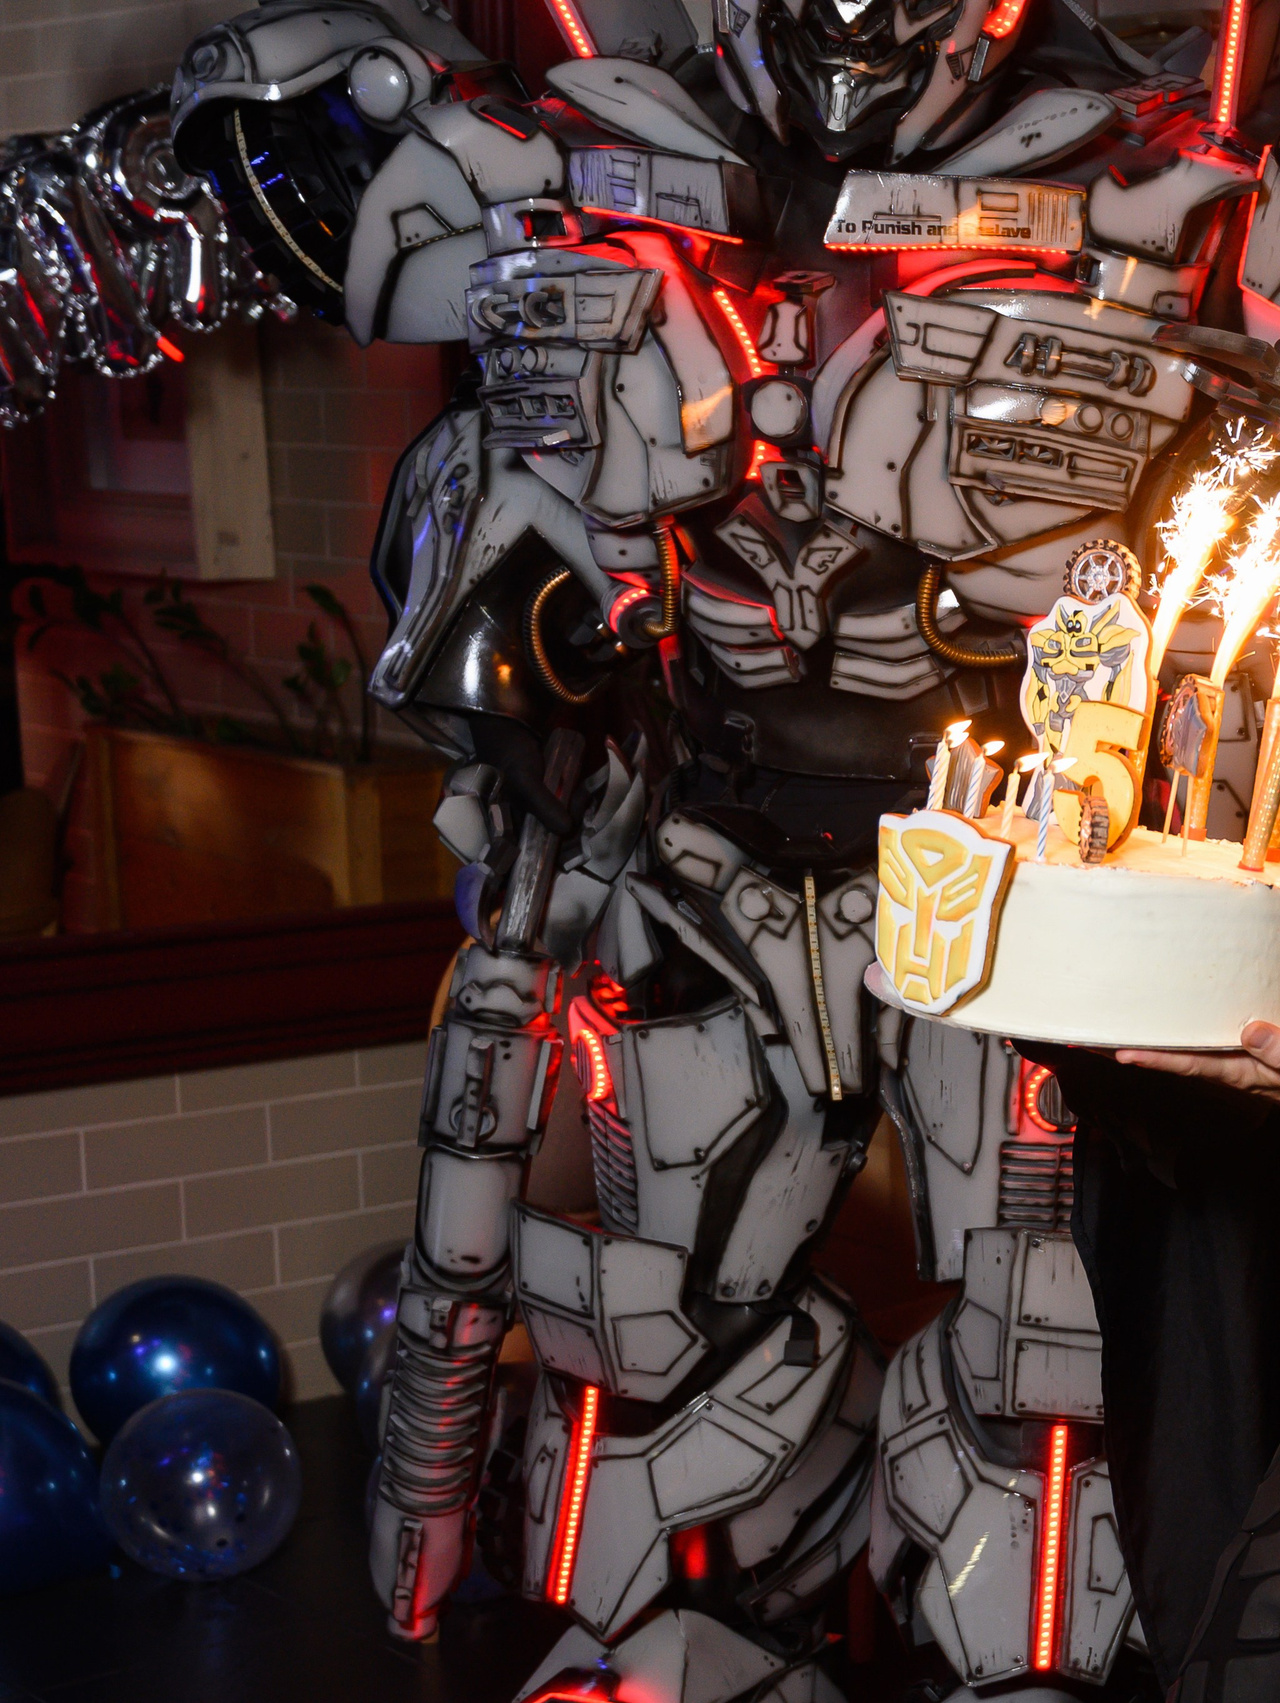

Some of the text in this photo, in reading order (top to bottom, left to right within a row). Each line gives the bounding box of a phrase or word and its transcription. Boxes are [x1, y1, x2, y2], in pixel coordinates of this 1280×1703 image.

[837, 219, 857, 233] To
[861, 220, 922, 235] Punish
[964, 222, 1031, 239] slave
[1053, 701, 1150, 854] 5
